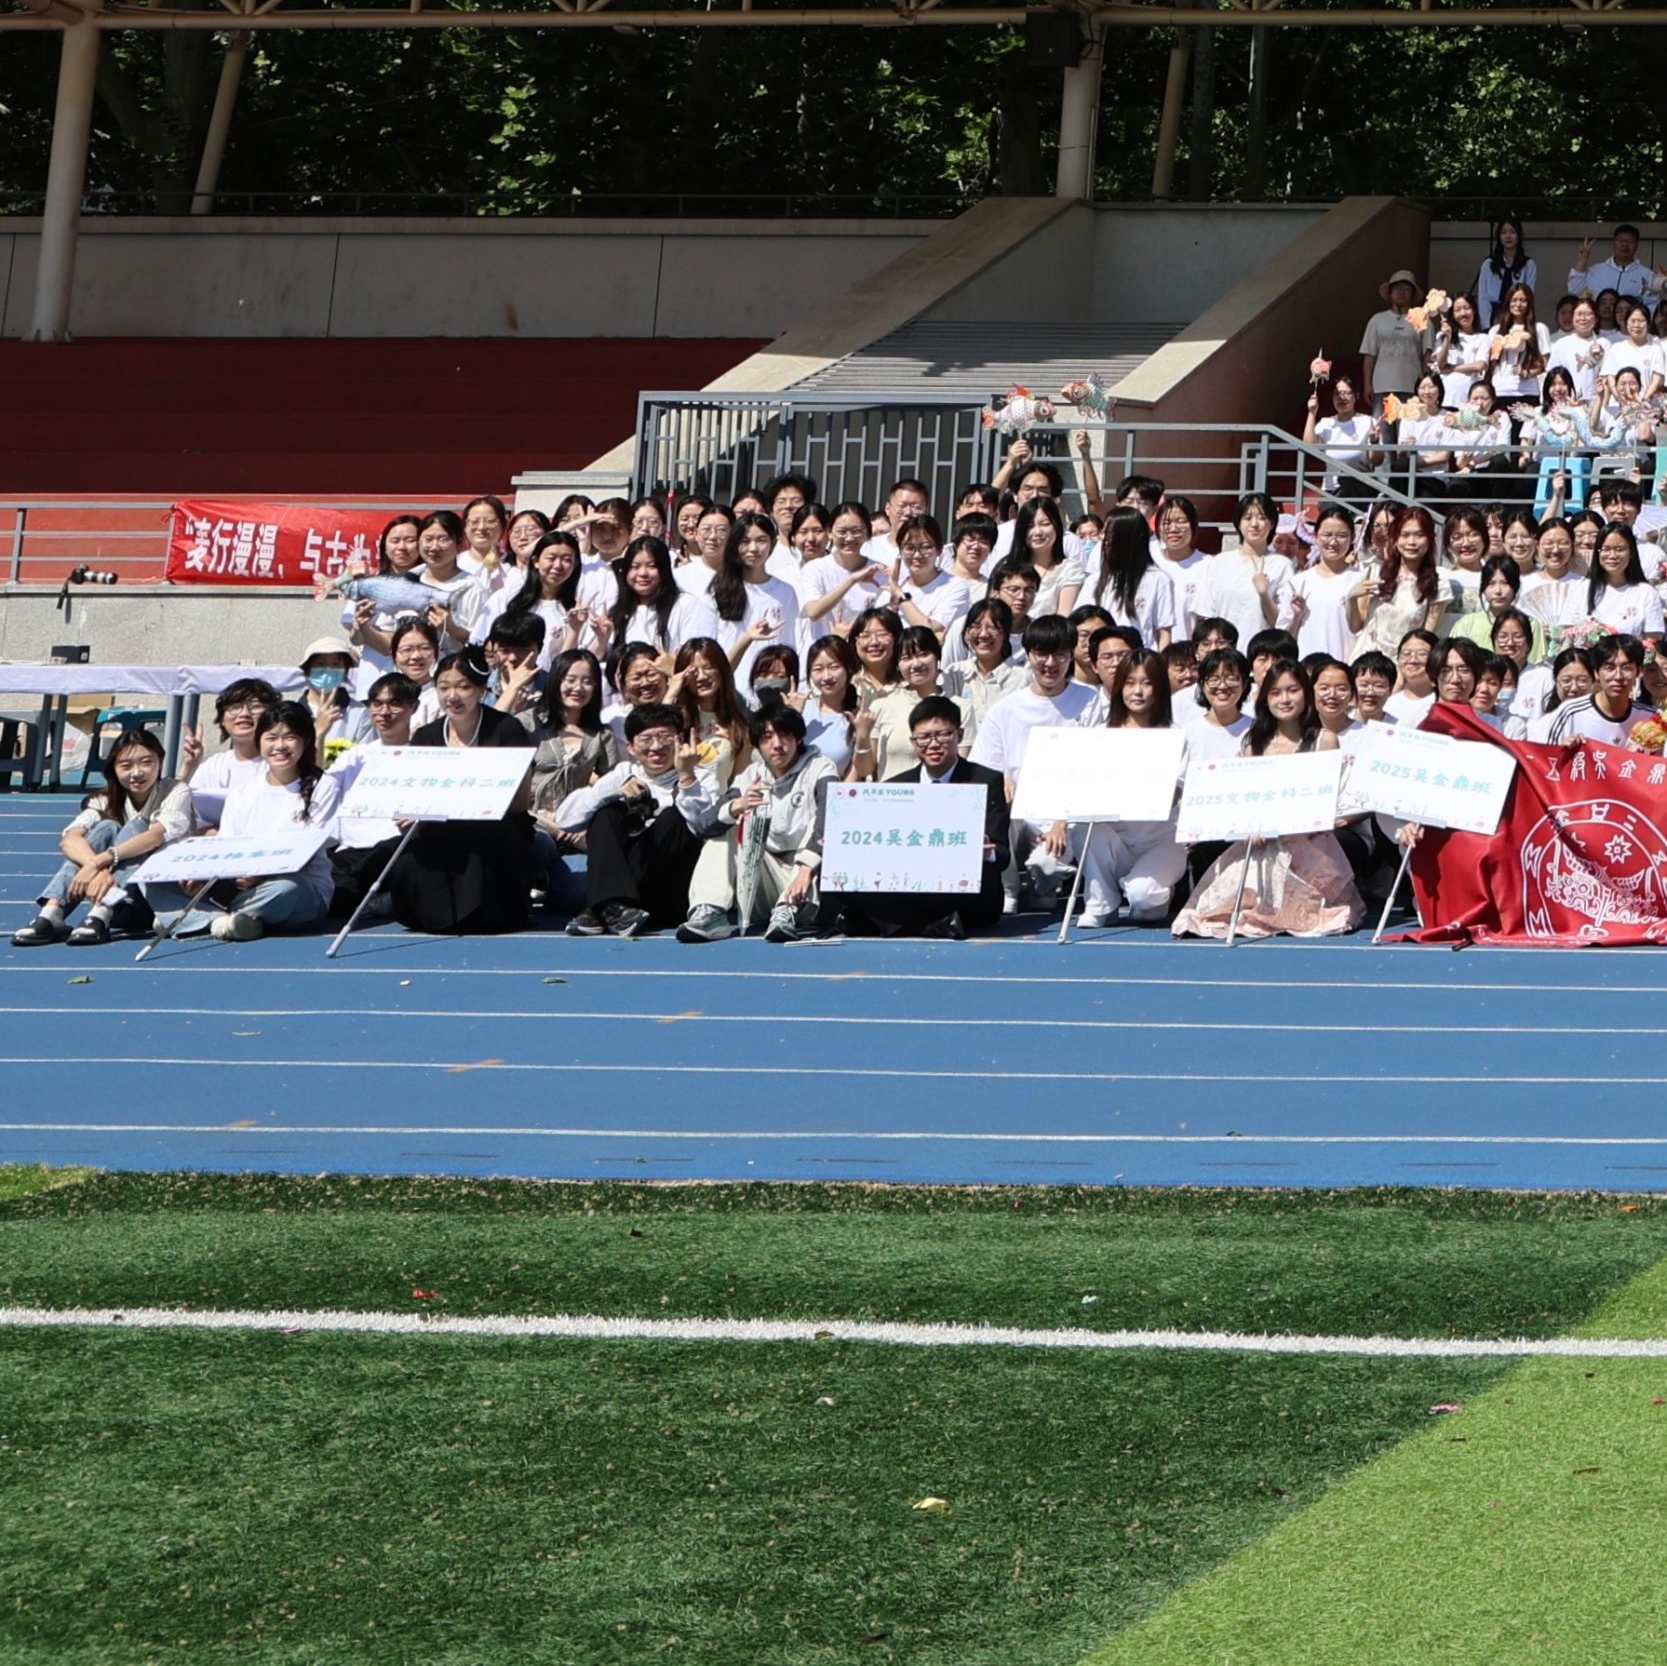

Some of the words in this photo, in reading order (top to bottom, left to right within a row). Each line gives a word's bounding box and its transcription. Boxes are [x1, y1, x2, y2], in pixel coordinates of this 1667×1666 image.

[1369, 760, 1492, 794] 2025吴金鼎班
[840, 827, 968, 849] 2024吴金鼎班
